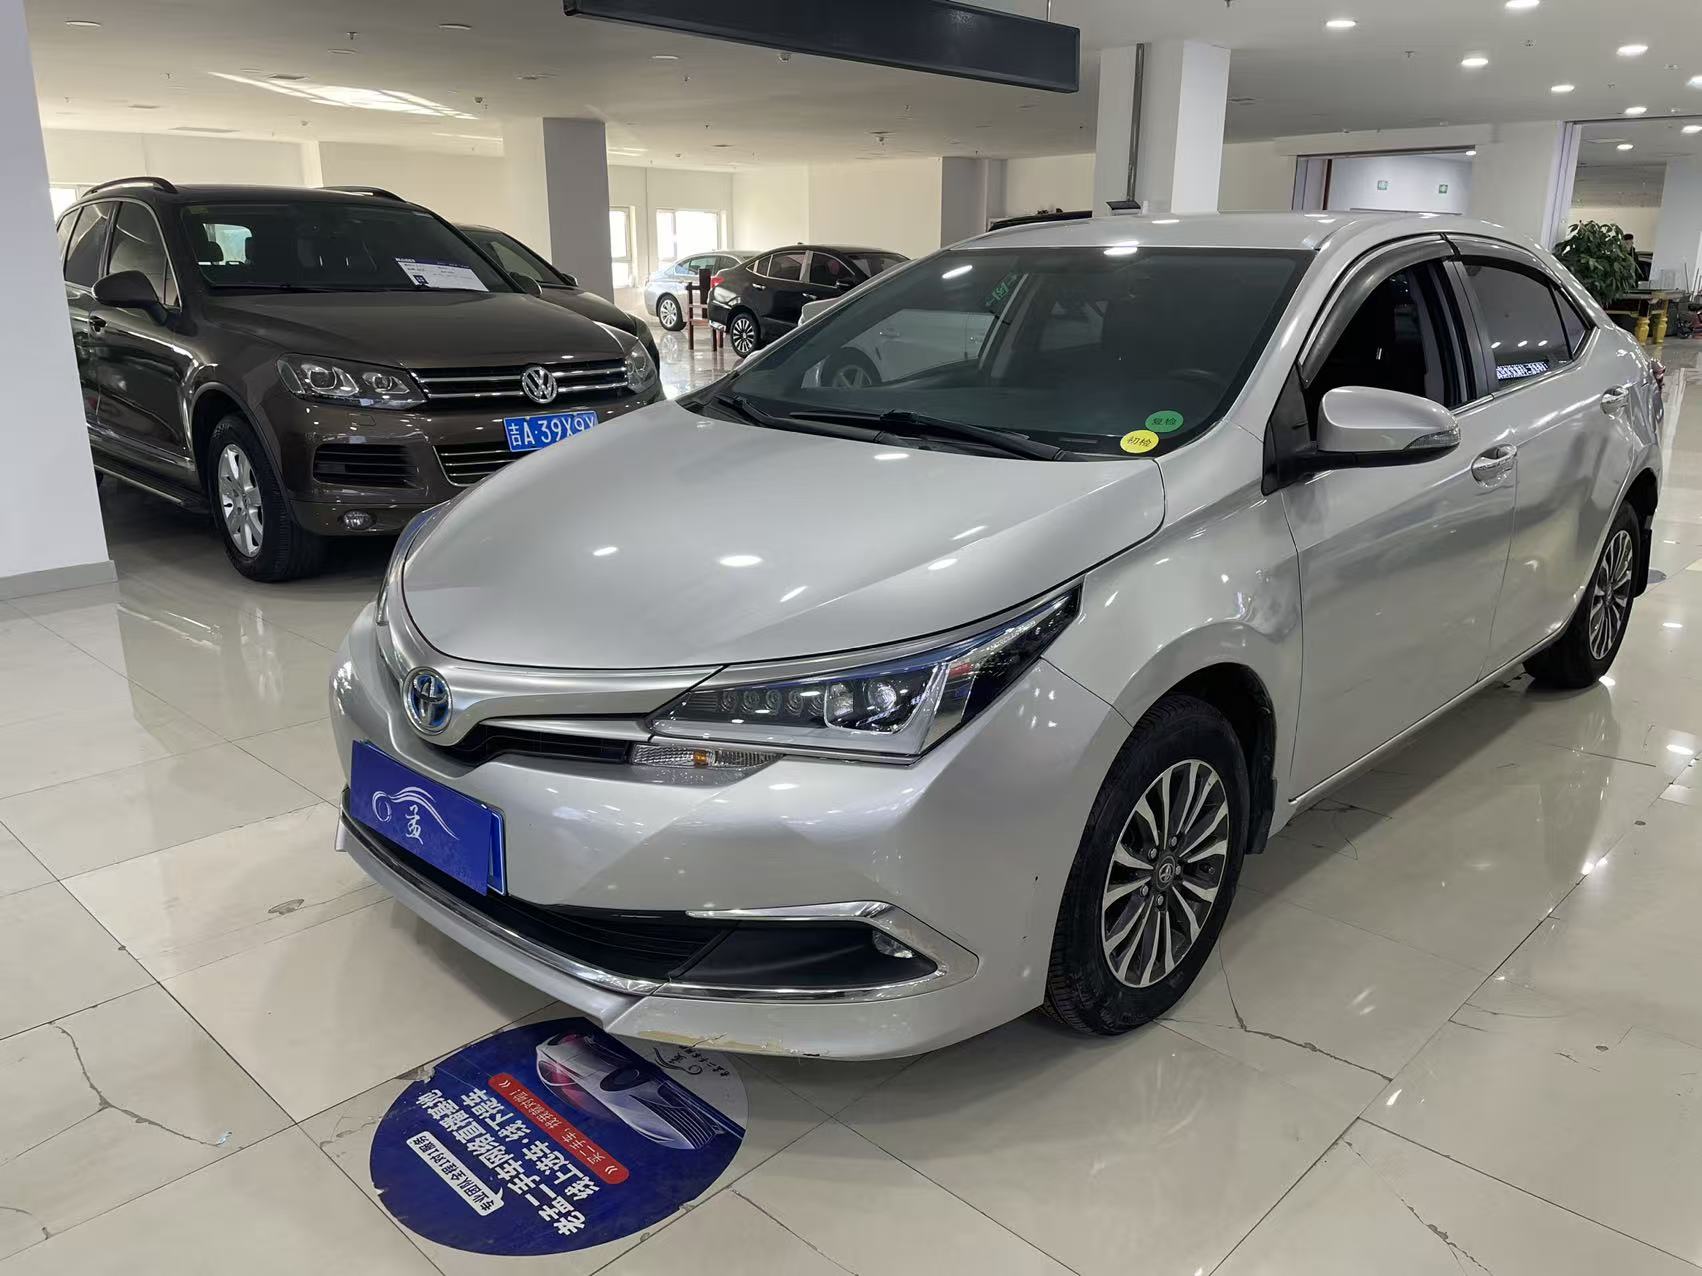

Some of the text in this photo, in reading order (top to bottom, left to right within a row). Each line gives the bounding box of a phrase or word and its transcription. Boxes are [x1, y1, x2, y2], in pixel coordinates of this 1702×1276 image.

[414, 1134, 495, 1212] 专业团队全程1对1服务
[415, 1089, 586, 1236] 老孟二手车网络直播基地
[460, 1087, 600, 1200] 线上选车·线下提车
